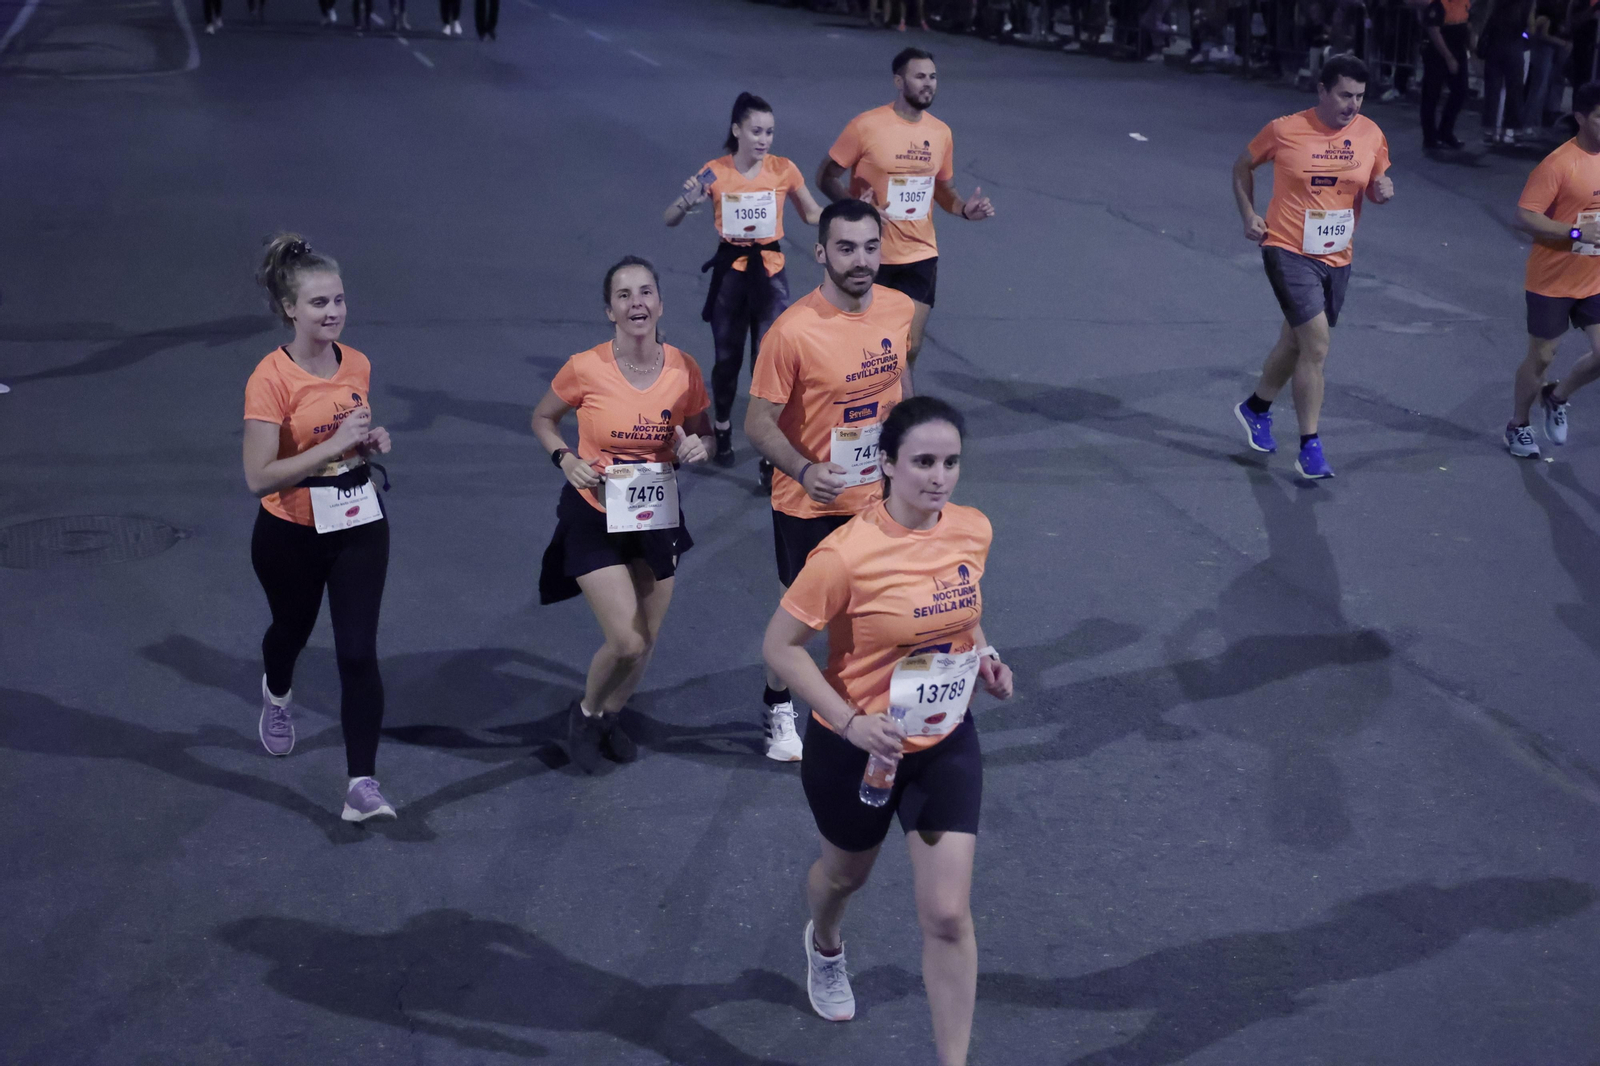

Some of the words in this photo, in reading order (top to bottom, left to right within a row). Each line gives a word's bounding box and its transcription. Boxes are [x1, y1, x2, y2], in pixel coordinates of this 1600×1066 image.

[899, 191, 926, 203] 13057
[735, 207, 767, 220] 13056
[1317, 224, 1346, 236] 14159
[861, 353, 898, 369] NOCTURNA
[845, 367, 879, 383] SEVILLA
[880, 361, 898, 373] KH7
[610, 430, 652, 440] SEVILLA
[653, 432, 675, 442] KH7
[632, 425, 675, 433] NOCTURNA
[854, 443, 879, 462] 747
[628, 485, 665, 503] 7476
[913, 601, 957, 619] SEVILLA
[958, 594, 977, 609] KH7
[916, 678, 966, 704] 13789
